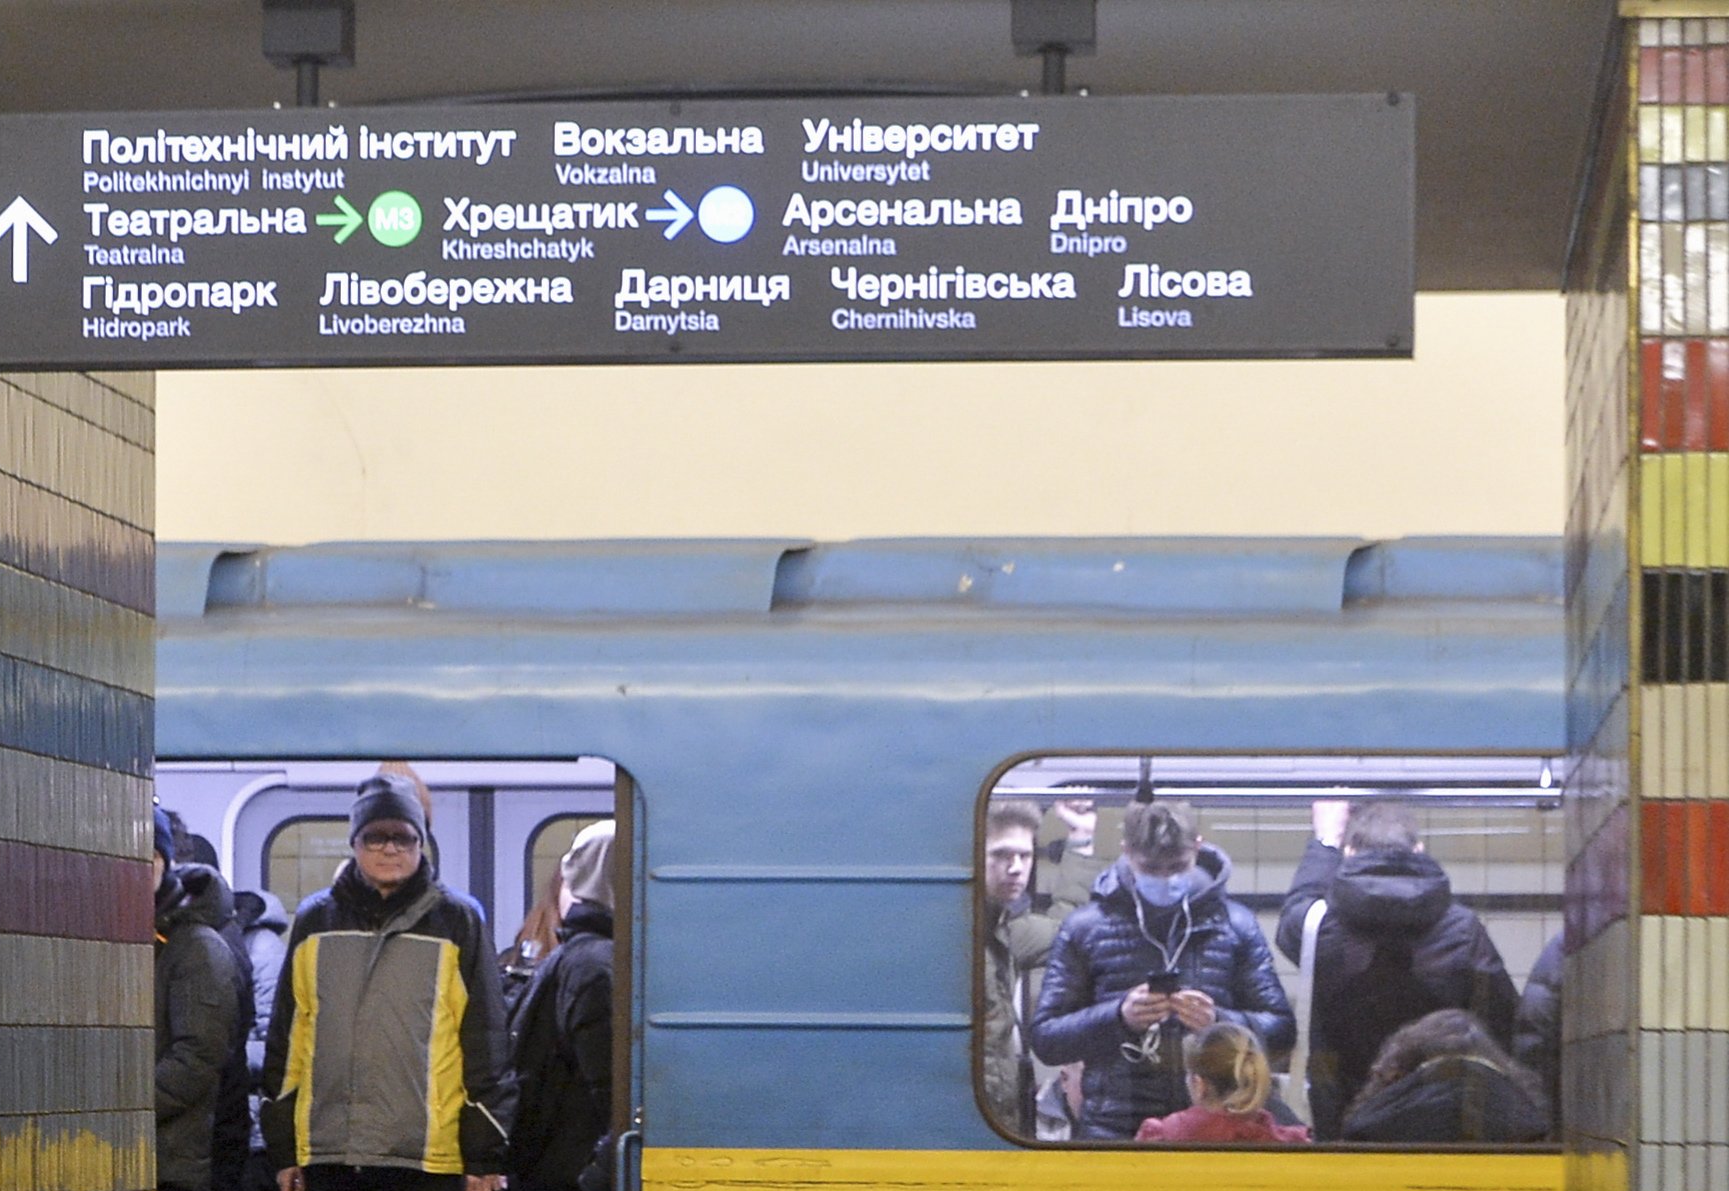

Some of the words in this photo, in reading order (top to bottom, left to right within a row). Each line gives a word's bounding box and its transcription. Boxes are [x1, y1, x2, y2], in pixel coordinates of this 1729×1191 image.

[83, 125, 348, 164] Політехнічний
[360, 125, 516, 165] інститут
[554, 122, 764, 156] Вокзальна
[802, 118, 1039, 159] Університет
[555, 162, 656, 185] Vokzalna
[802, 160, 930, 185] Universytet
[84, 203, 307, 242] Театральна
[443, 197, 639, 237] Хрещатик
[782, 193, 1023, 233] Арсенальна
[1050, 190, 1193, 230] Дніпро
[84, 243, 185, 265] Teatralna
[443, 237, 594, 263] Khreshchatyk
[783, 234, 896, 256] Arsenalna
[1051, 232, 1127, 257] Dnipro
[83, 276, 277, 315] Гідропарк
[320, 271, 573, 311] Лівобережна
[615, 269, 789, 308] Дарниця
[831, 266, 1076, 307] Чернігівська
[1118, 264, 1253, 297] Лісова
[83, 316, 190, 341] Hidropark
[320, 313, 465, 335] Livoberezhna
[615, 310, 719, 335] Darnytsia
[832, 308, 976, 329] Chernihivska
[1118, 306, 1192, 327] Lisova
